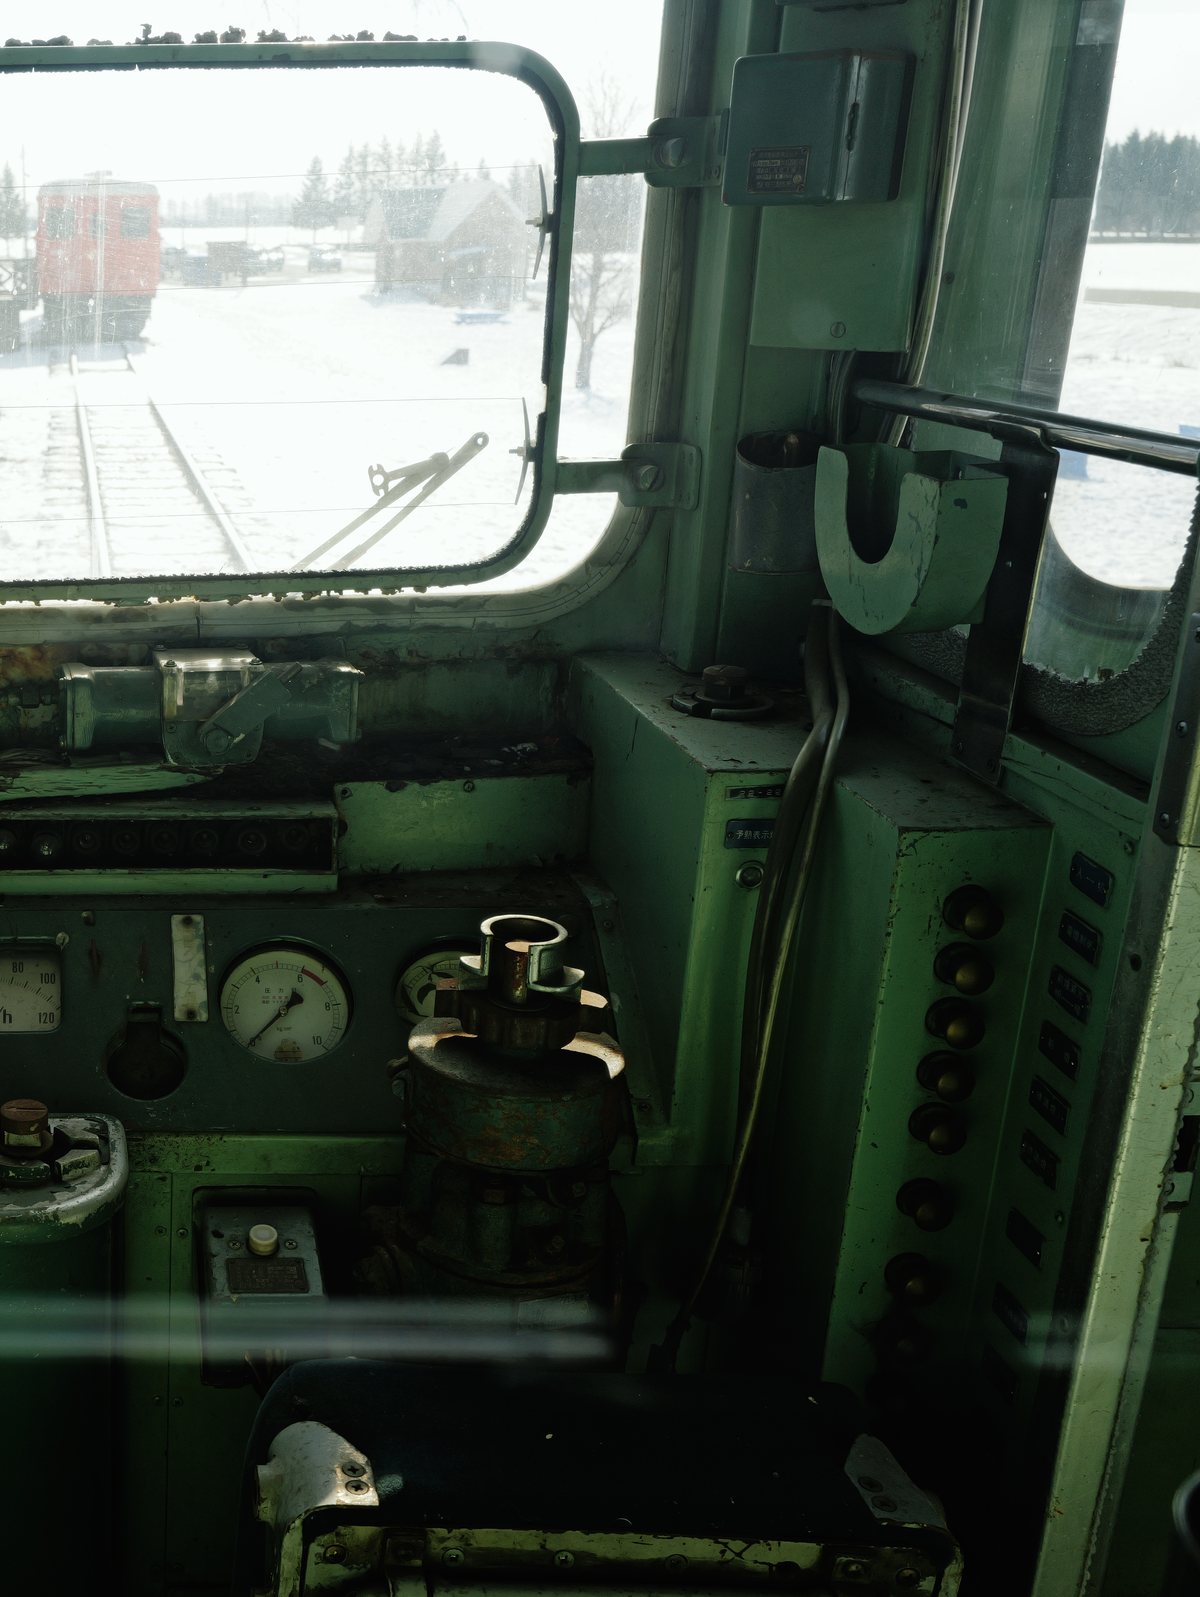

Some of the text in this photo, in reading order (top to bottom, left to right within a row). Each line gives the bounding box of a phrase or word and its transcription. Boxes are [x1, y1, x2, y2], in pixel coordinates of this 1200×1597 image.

[12, 961, 24, 974] 80
[40, 973, 56, 985] 100
[38, 1012, 55, 1024] 120
[312, 1035, 322, 1046] 10
